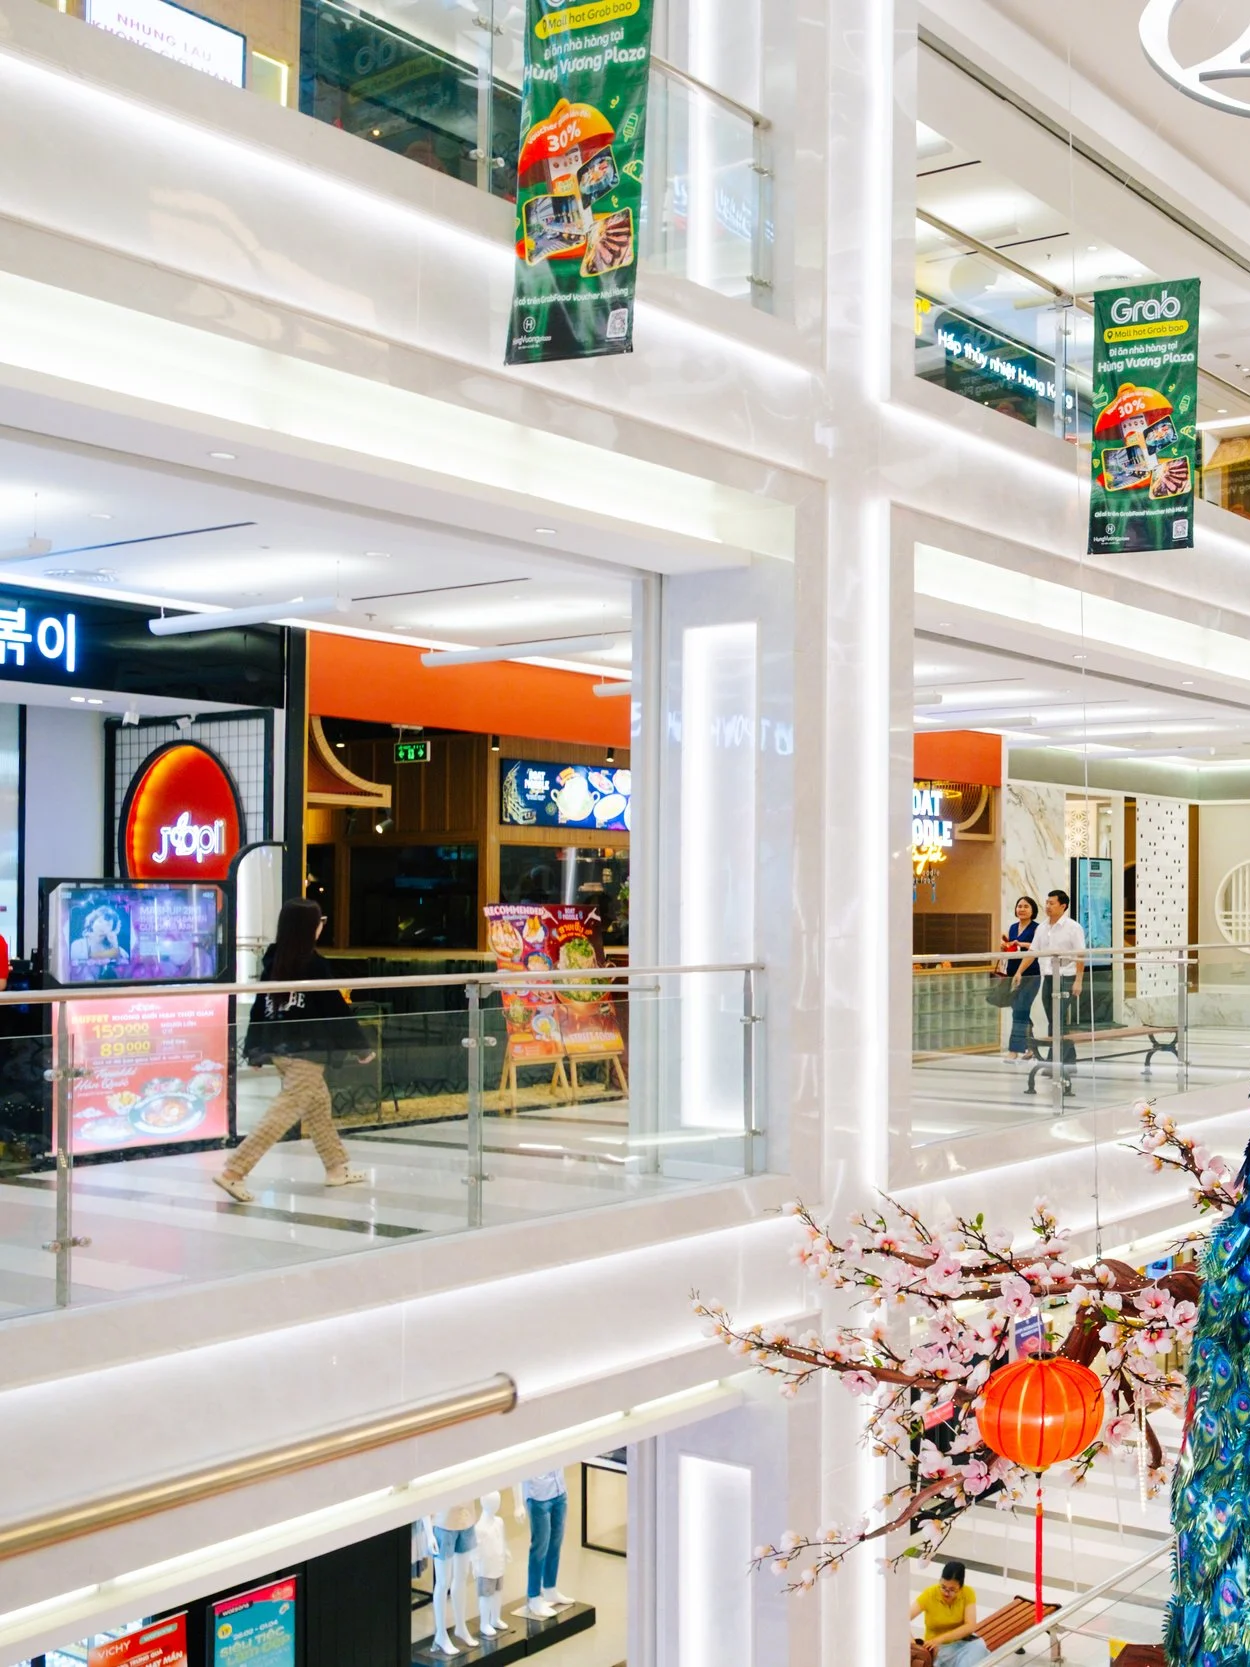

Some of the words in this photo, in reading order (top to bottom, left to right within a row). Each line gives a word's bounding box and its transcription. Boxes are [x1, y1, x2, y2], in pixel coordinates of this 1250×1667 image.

[569, 12, 585, 24] hot
[587, 6, 611, 20] Grab
[613, 1, 632, 14] bao
[563, 36, 583, 53] nhà
[584, 31, 609, 49] hàng
[524, 62, 558, 82] Hùng
[560, 53, 602, 75] Vương
[604, 45, 647, 65] Plaza
[546, 120, 582, 153] 30%
[1111, 290, 1181, 324] Grab
[1114, 330, 1132, 339] Mall
[1133, 328, 1146, 337] hot
[1147, 325, 1167, 335] Grab
[1168, 323, 1184, 333] bao
[1128, 344, 1145, 355] nhà
[1145, 342, 1166, 354] hàng
[937, 328, 962, 356] Hấp
[1018, 367, 1046, 397] Hong
[1097, 360, 1125, 373] Hùng
[1126, 357, 1161, 369] Vương
[1163, 352, 1195, 365] Plaza
[1117, 397, 1146, 418] 30%
[484, 905, 546, 917] RECOMMENDED
[222, 1602, 250, 1617] watsons
[97, 1640, 131, 1660] VICHY
